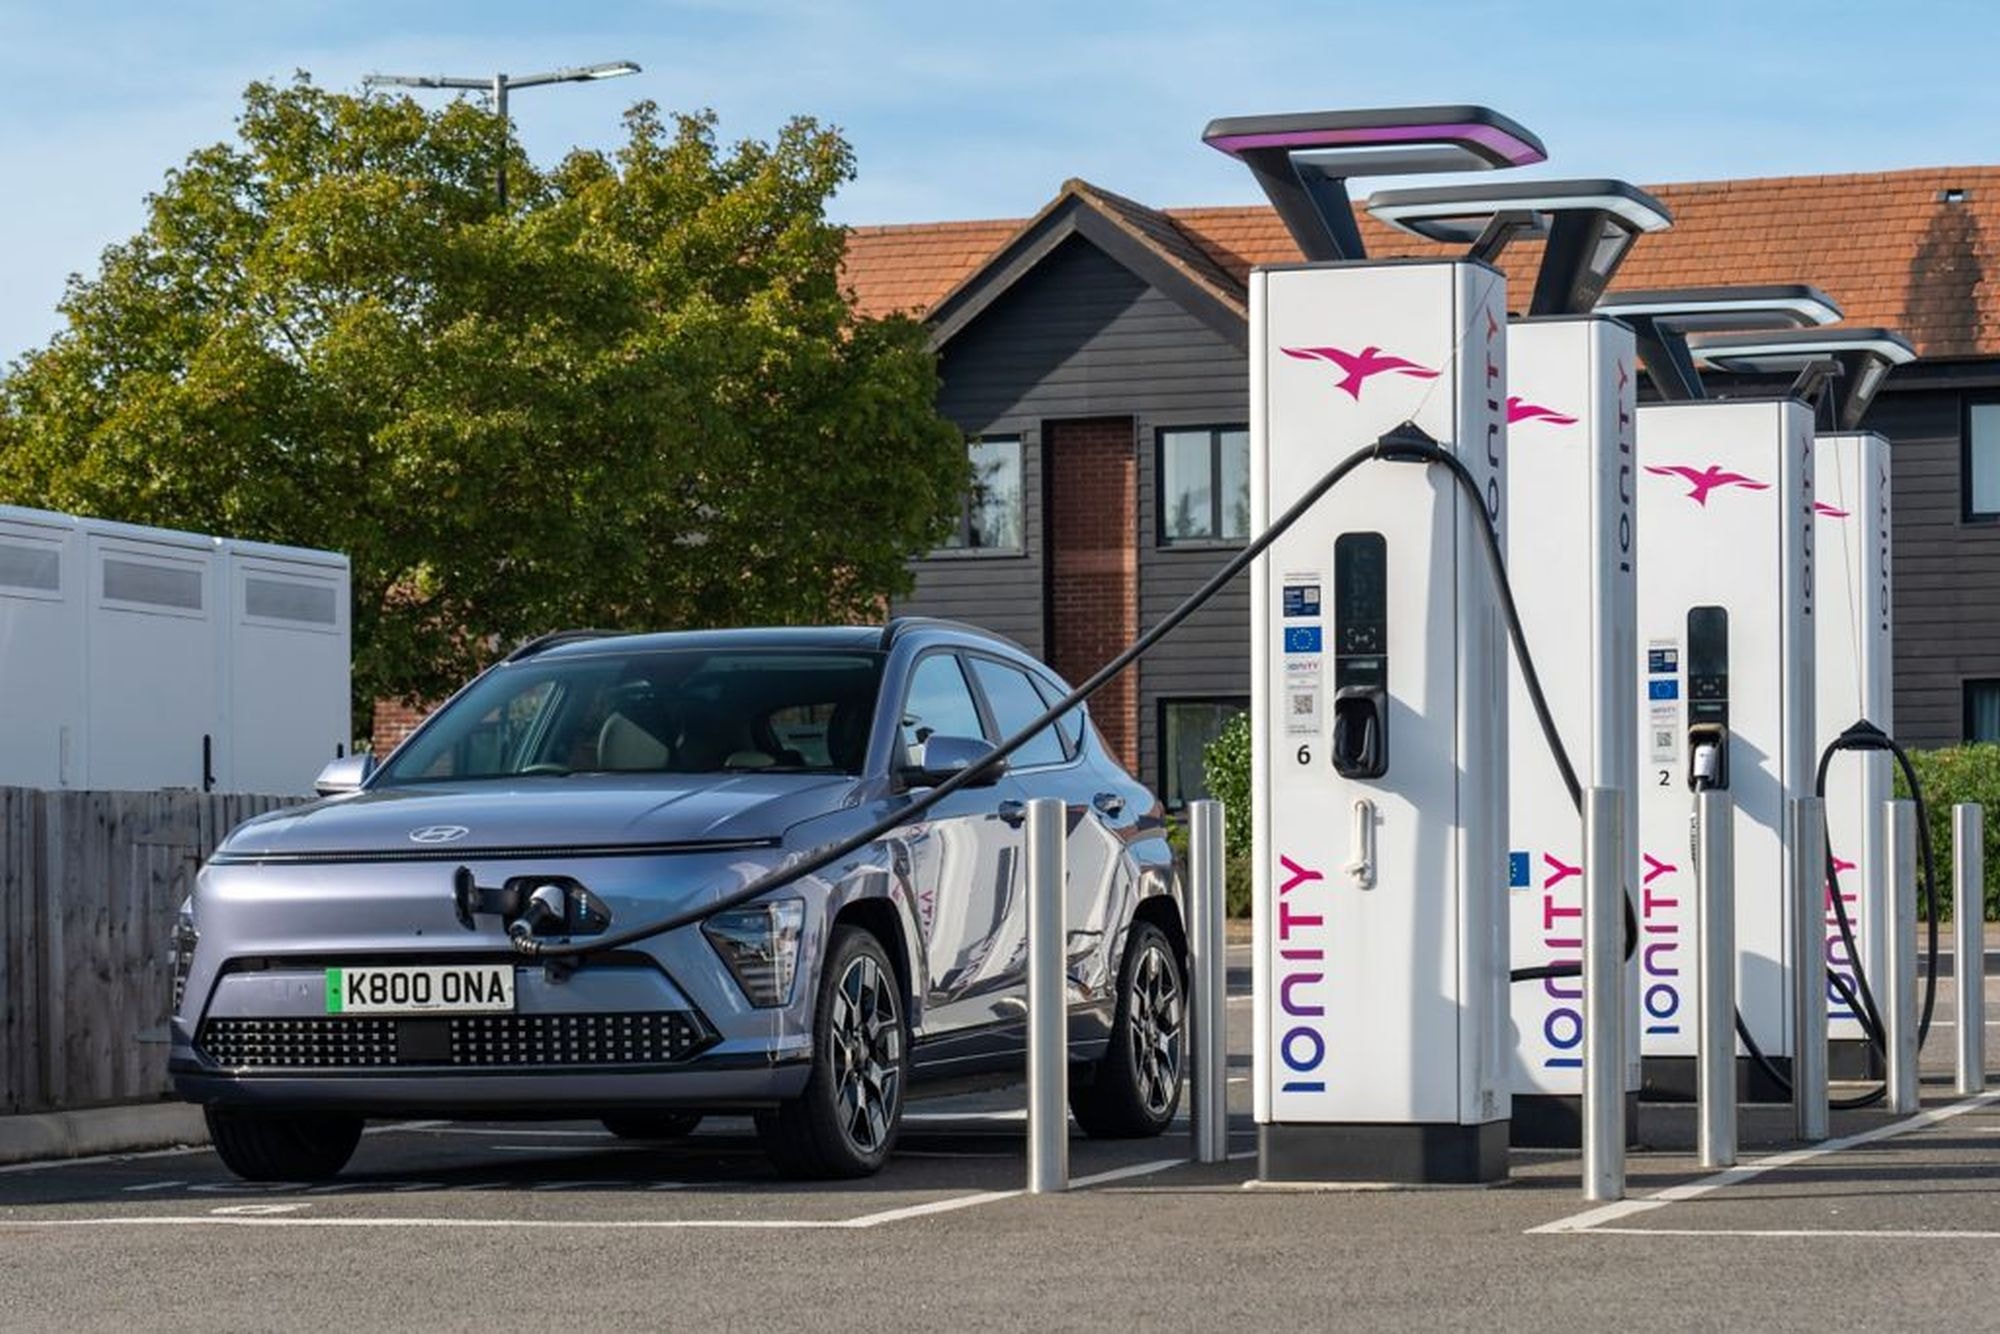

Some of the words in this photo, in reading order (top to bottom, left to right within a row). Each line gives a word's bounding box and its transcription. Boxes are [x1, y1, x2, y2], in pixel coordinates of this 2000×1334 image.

[1487, 306, 1499, 546] ONITY
[1297, 744, 1311, 765] 6
[1659, 770, 1670, 786] 2
[349, 972, 430, 1004] K800
[442, 970, 505, 1003] ONA
[1280, 854, 1325, 1092] IONITY
[1544, 852, 1583, 1068] IONITY
[1643, 852, 1680, 1034] IONITY
